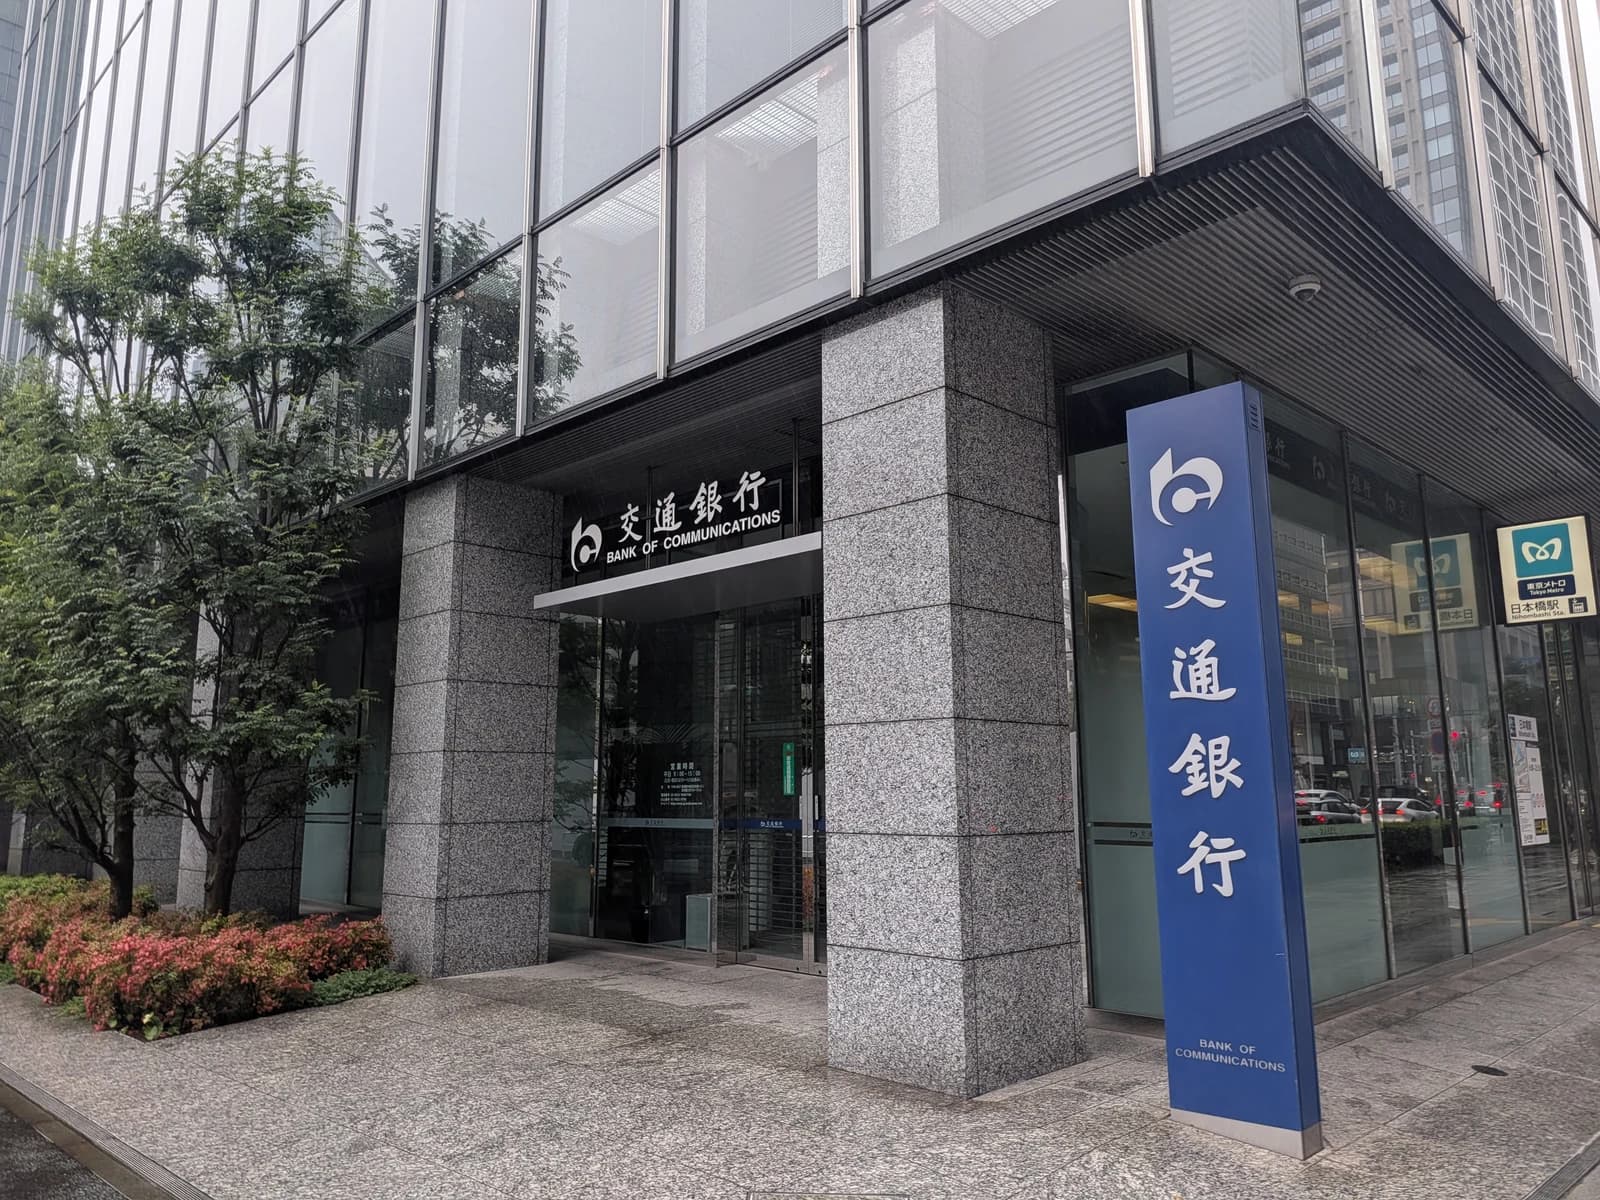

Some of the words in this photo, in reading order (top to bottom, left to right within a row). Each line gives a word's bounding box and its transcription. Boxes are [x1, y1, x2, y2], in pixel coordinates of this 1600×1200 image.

[618, 470, 767, 543] 交通銀行
[606, 544, 637, 564] BANK
[642, 540, 658, 555] OF
[663, 509, 781, 549] COMMUNICATIONS
[1511, 600, 1560, 614] 日本橋駅
[1164, 547, 1247, 897] 交通銀行
[1175, 1048, 1286, 1073] COMMUNICATIONS
[1199, 1039, 1233, 1052] BANK
[1239, 1044, 1256, 1055] OF
